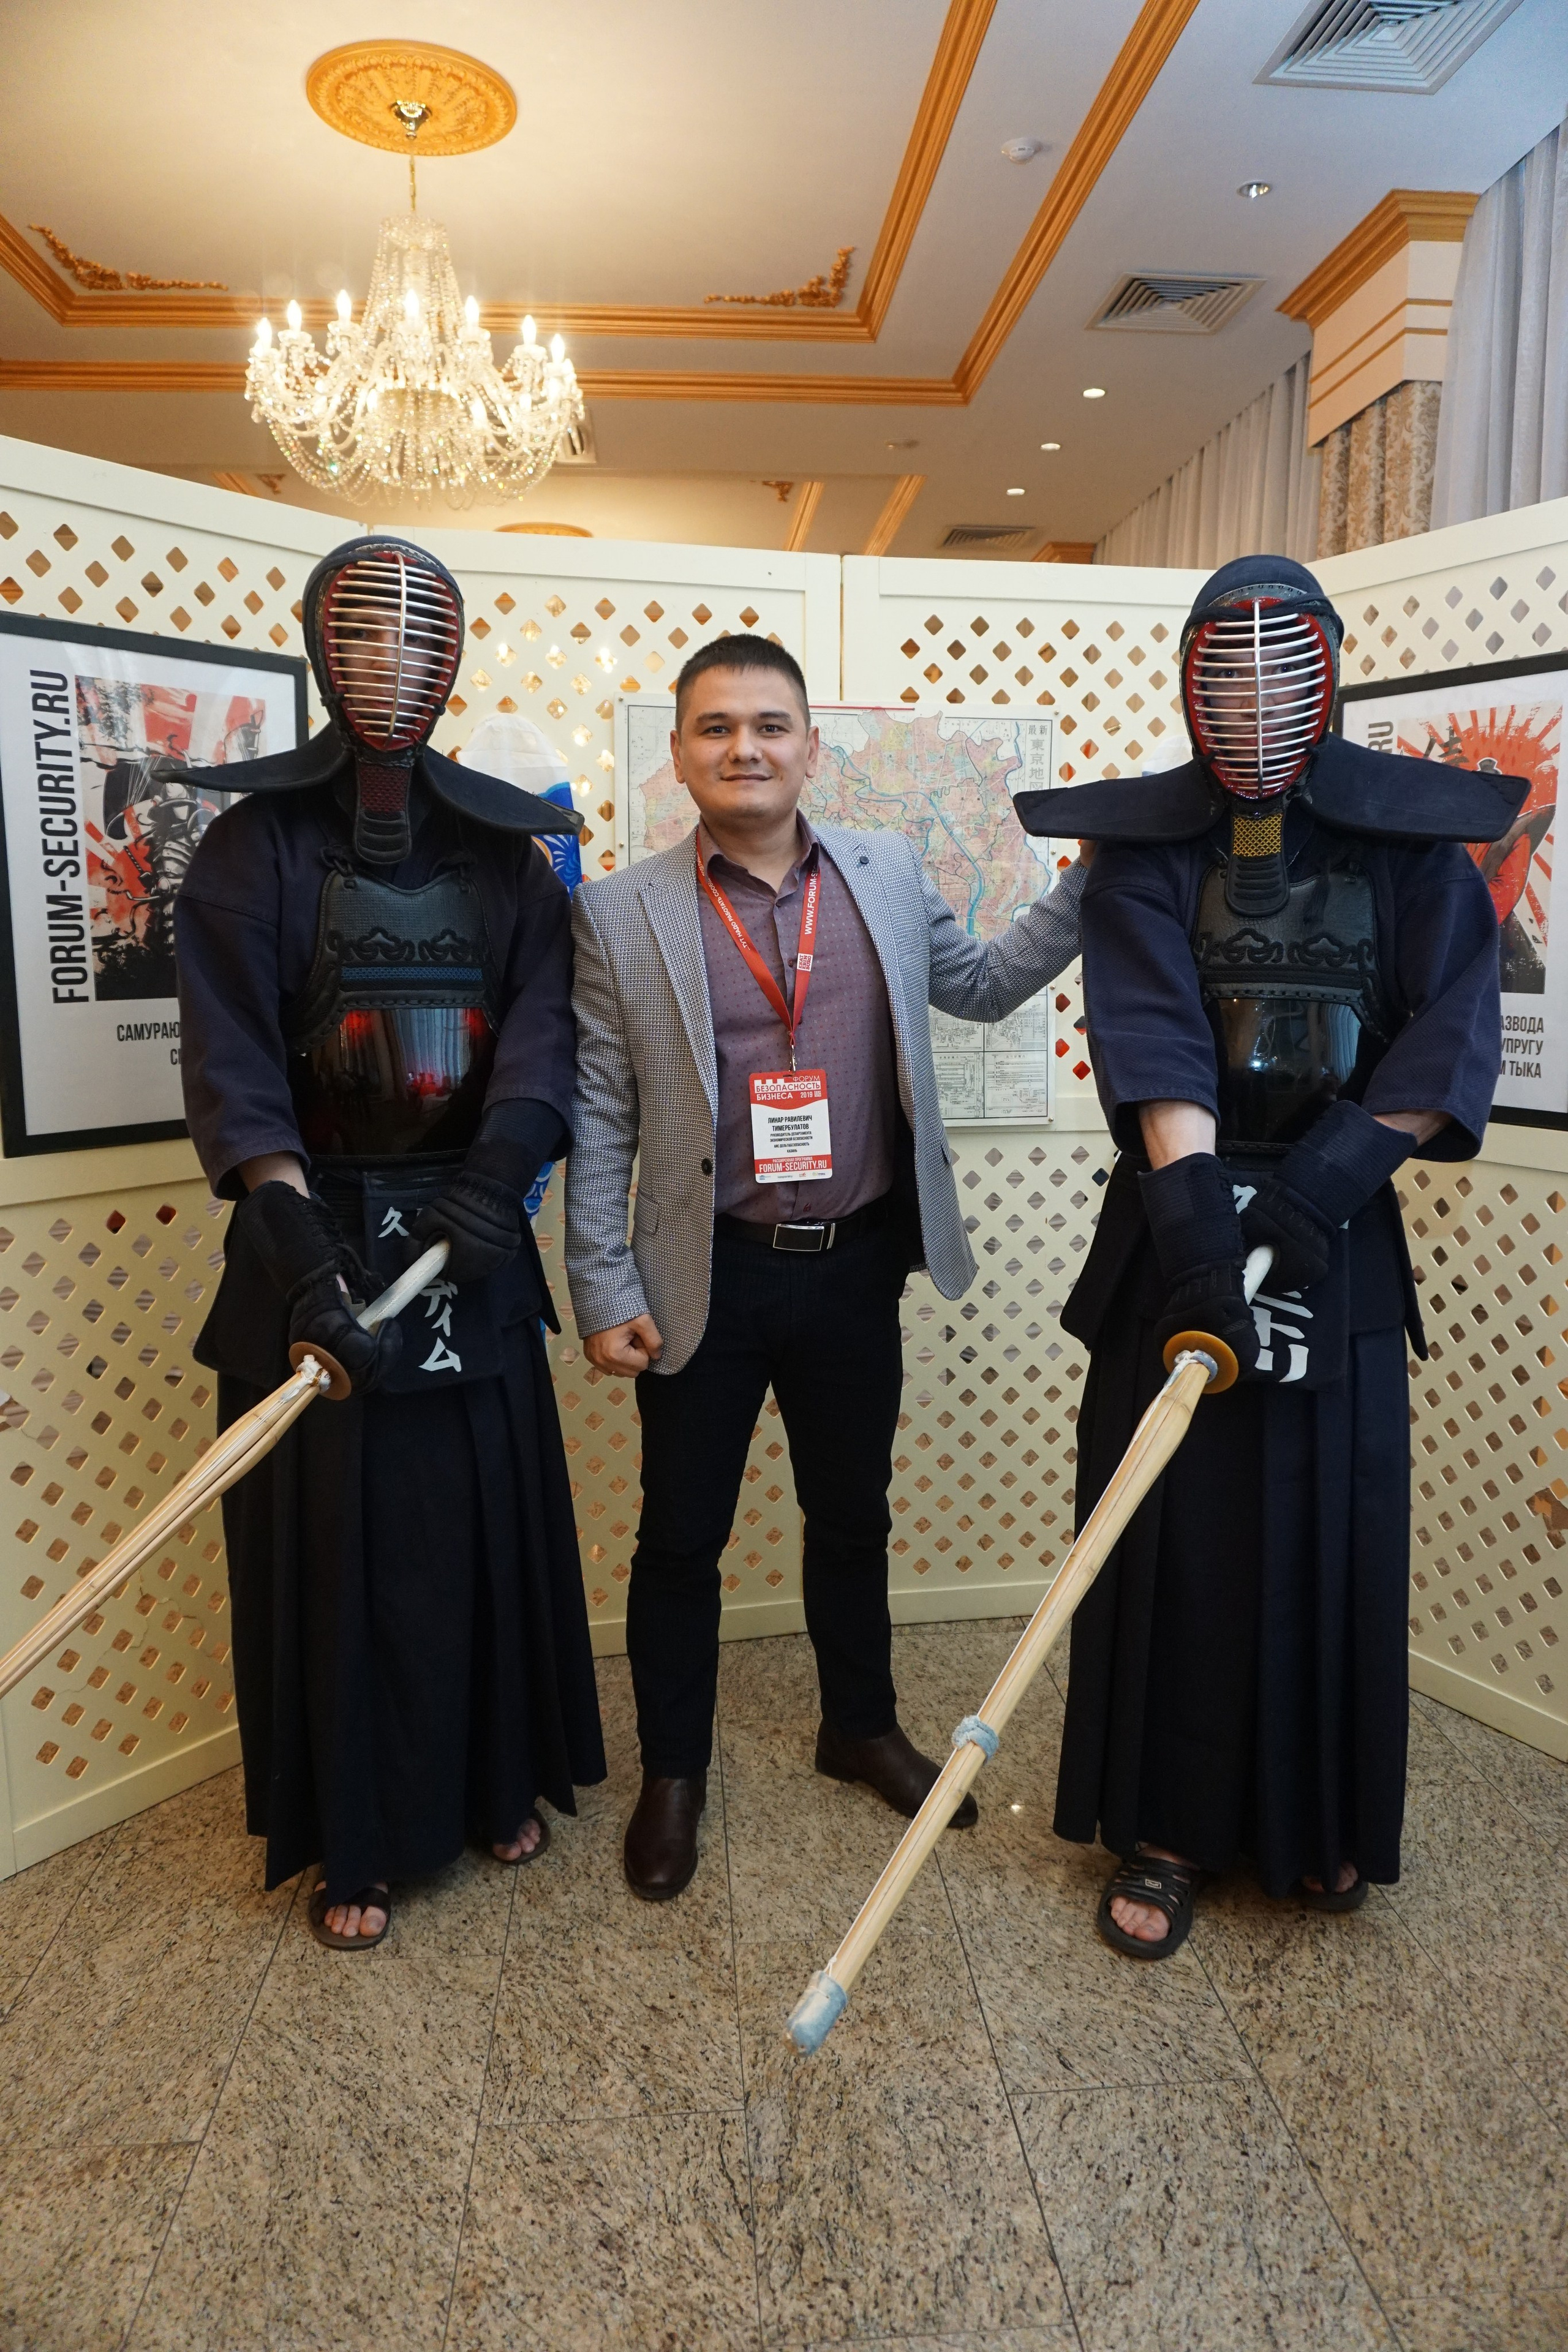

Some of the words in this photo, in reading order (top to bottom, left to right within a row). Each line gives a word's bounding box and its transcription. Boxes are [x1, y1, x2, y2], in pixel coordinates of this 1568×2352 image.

[29, 669, 89, 1004] FORUM-SECURITY.RU
[717, 897, 734, 922] РАБОТАТЬ
[731, 921, 744, 938] НАДО
[1509, 1060, 1542, 1078] ТЫКА
[756, 1083, 820, 1092] БЕЗОПАСНОСТЬ
[760, 1159, 827, 1173] FORUM-SECURITY.RU
